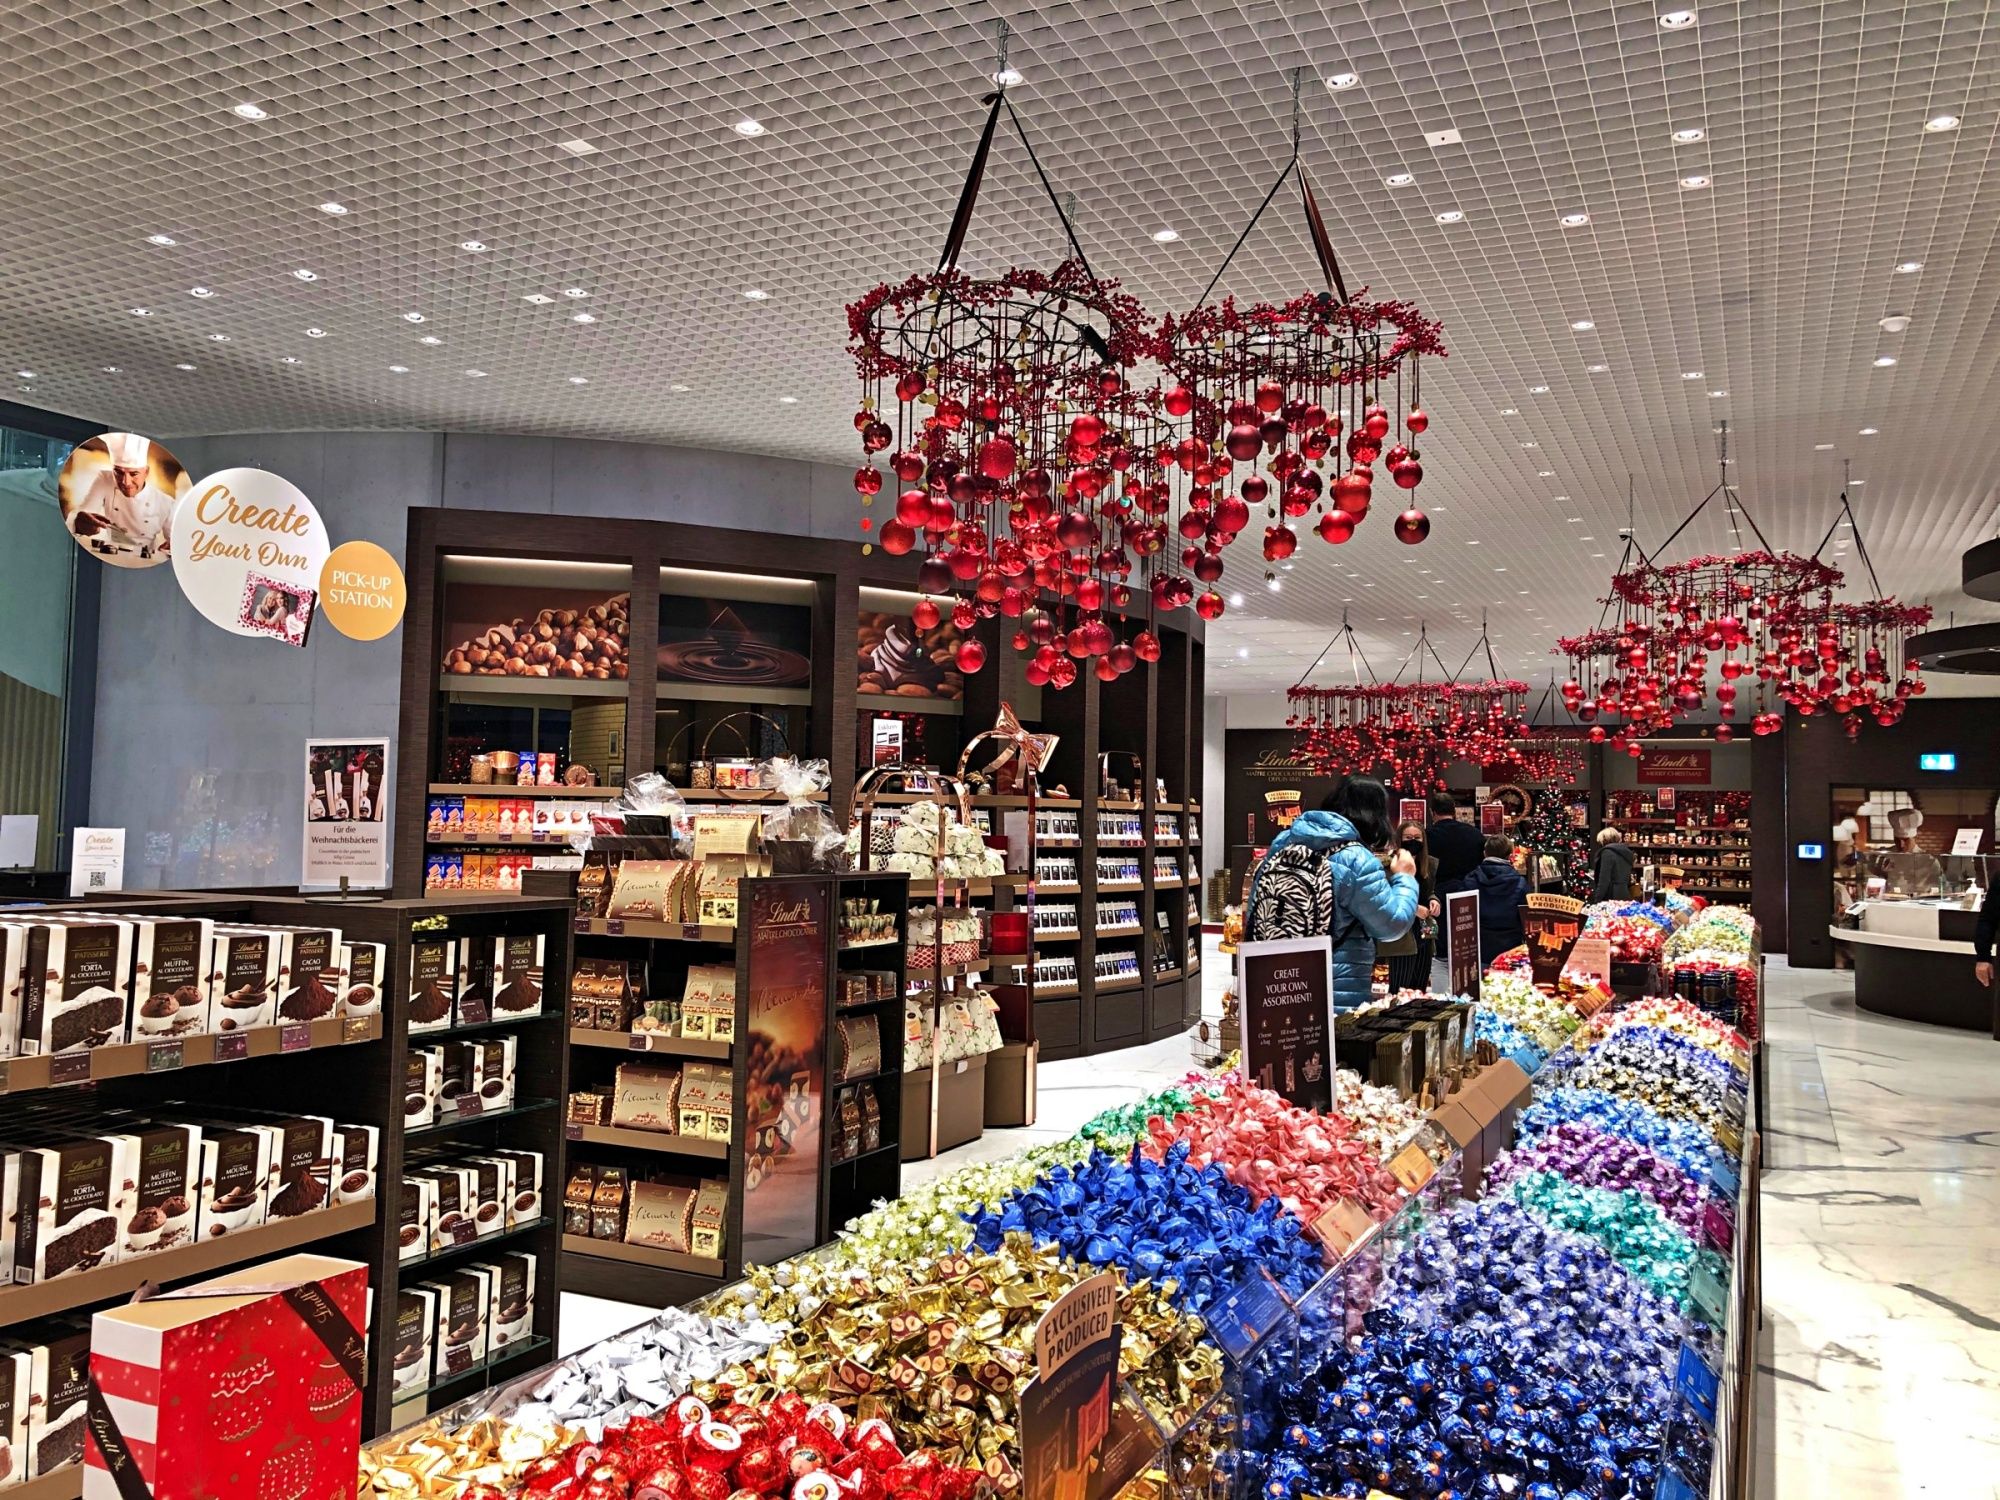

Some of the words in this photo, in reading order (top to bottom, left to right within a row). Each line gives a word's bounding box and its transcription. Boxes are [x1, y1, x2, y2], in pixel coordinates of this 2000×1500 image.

[196, 484, 310, 537] Create
[190, 530, 251, 562] Your
[257, 542, 309, 571] Own
[332, 569, 391, 591] PICK-UP
[329, 589, 393, 610] STATION
[1650, 754, 1689, 767] Lindt
[333, 825, 344, 834] Für
[345, 825, 356, 833] die
[1530, 896, 1579, 908] EXCLUSIVELY
[1532, 902, 1576, 913] PRODUCED
[766, 900, 802, 923] Lindt
[778, 927, 818, 938] CHOCOLATIER
[236, 942, 258, 952] Lindt
[301, 937, 320, 946] Lindt
[80, 964, 103, 972] TORTA
[164, 960, 189, 968] MUFFIN
[301, 958, 321, 966] CACAO
[1273, 967, 1300, 980] CREATE
[1265, 983, 1288, 995] YOUR
[1288, 981, 1308, 993] OWN
[1262, 992, 1313, 1008] ASSORTMENT!
[292, 1151, 313, 1161] CACAO
[151, 1170, 177, 1181] MUFFIN
[226, 1165, 249, 1175] MOUSSE
[70, 1190, 105, 1202] CIOCCOLATO
[73, 1186, 96, 1196] TORTA
[1044, 1284, 1114, 1345] EXCLUSIVELY
[1048, 1311, 1108, 1369] PRODUCED
[60, 1384, 88, 1397] CIOCCOLA
